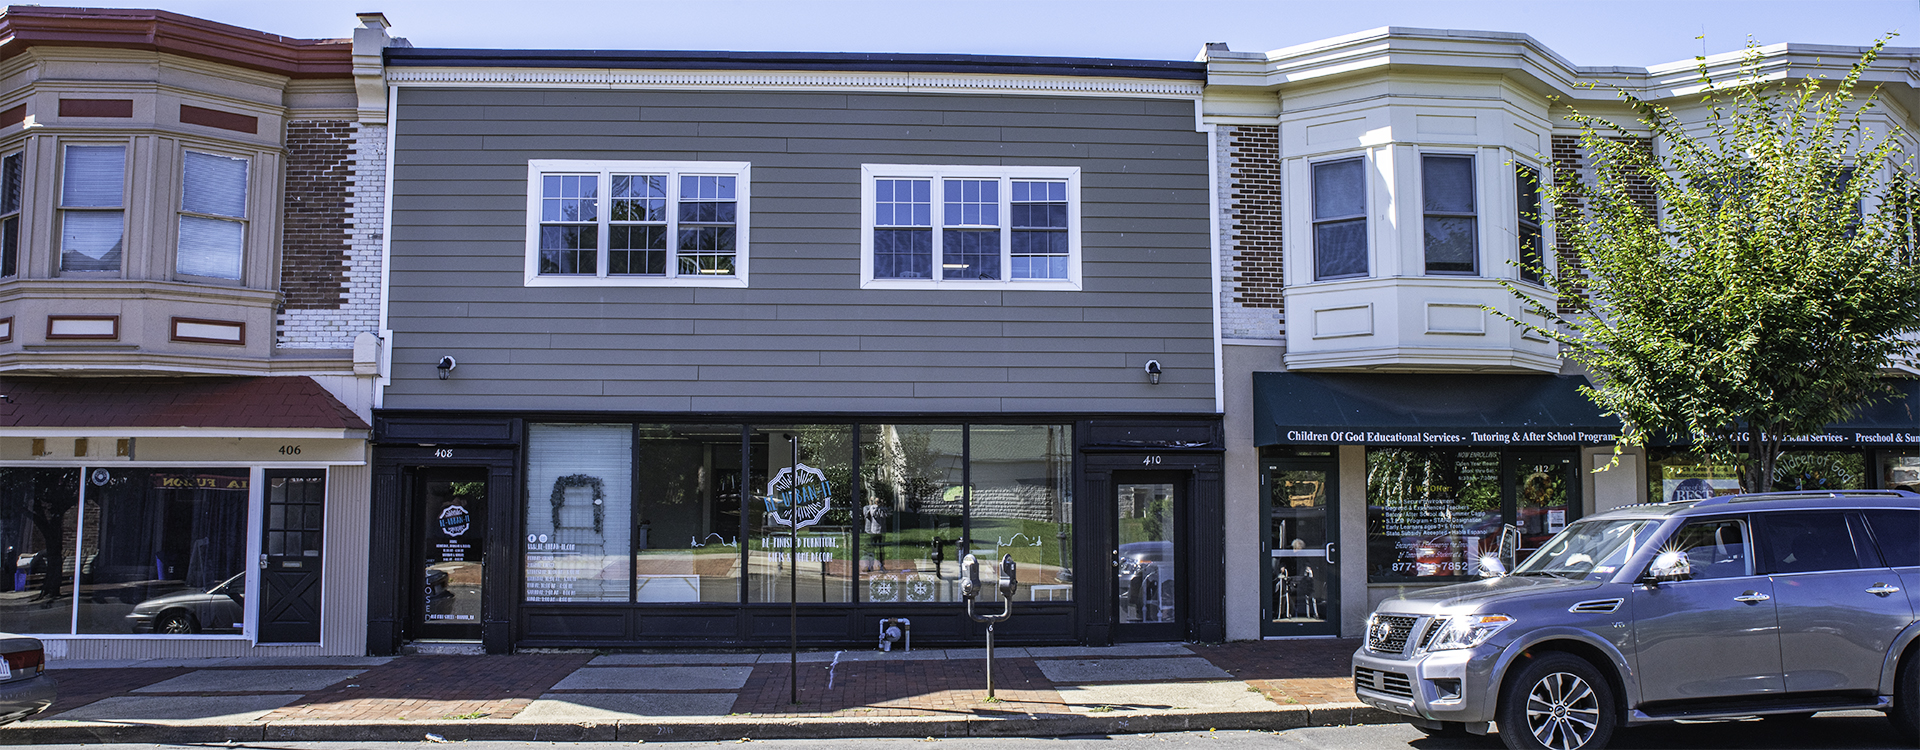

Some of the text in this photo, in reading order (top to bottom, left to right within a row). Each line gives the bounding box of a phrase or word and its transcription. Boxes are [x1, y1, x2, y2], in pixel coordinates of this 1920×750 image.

[1287, 430, 1329, 441] Children
[1330, 431, 1344, 442] Of
[1344, 431, 1365, 442] God
[1366, 432, 1422, 442] Educational
[1423, 432, 1461, 442] Services
[1470, 432, 1511, 445] Tutoring
[1511, 432, 1521, 442] &
[1521, 432, 1546, 442] After
[1546, 432, 1577, 442] School
[1810, 433, 1844, 442] Services
[1855, 433, 1894, 442] Preschool
[1894, 433, 1904, 442] &
[278, 444, 302, 456] 406
[434, 448, 453, 458] 408
[1142, 455, 1162, 466] 410
[1533, 464, 1549, 473] 412
[1772, 452, 1855, 484] Children of God
[1430, 484, 1453, 492] Offer:
[1676, 490, 1714, 500] BEST
[1391, 562, 1469, 572] 877-2-7852
